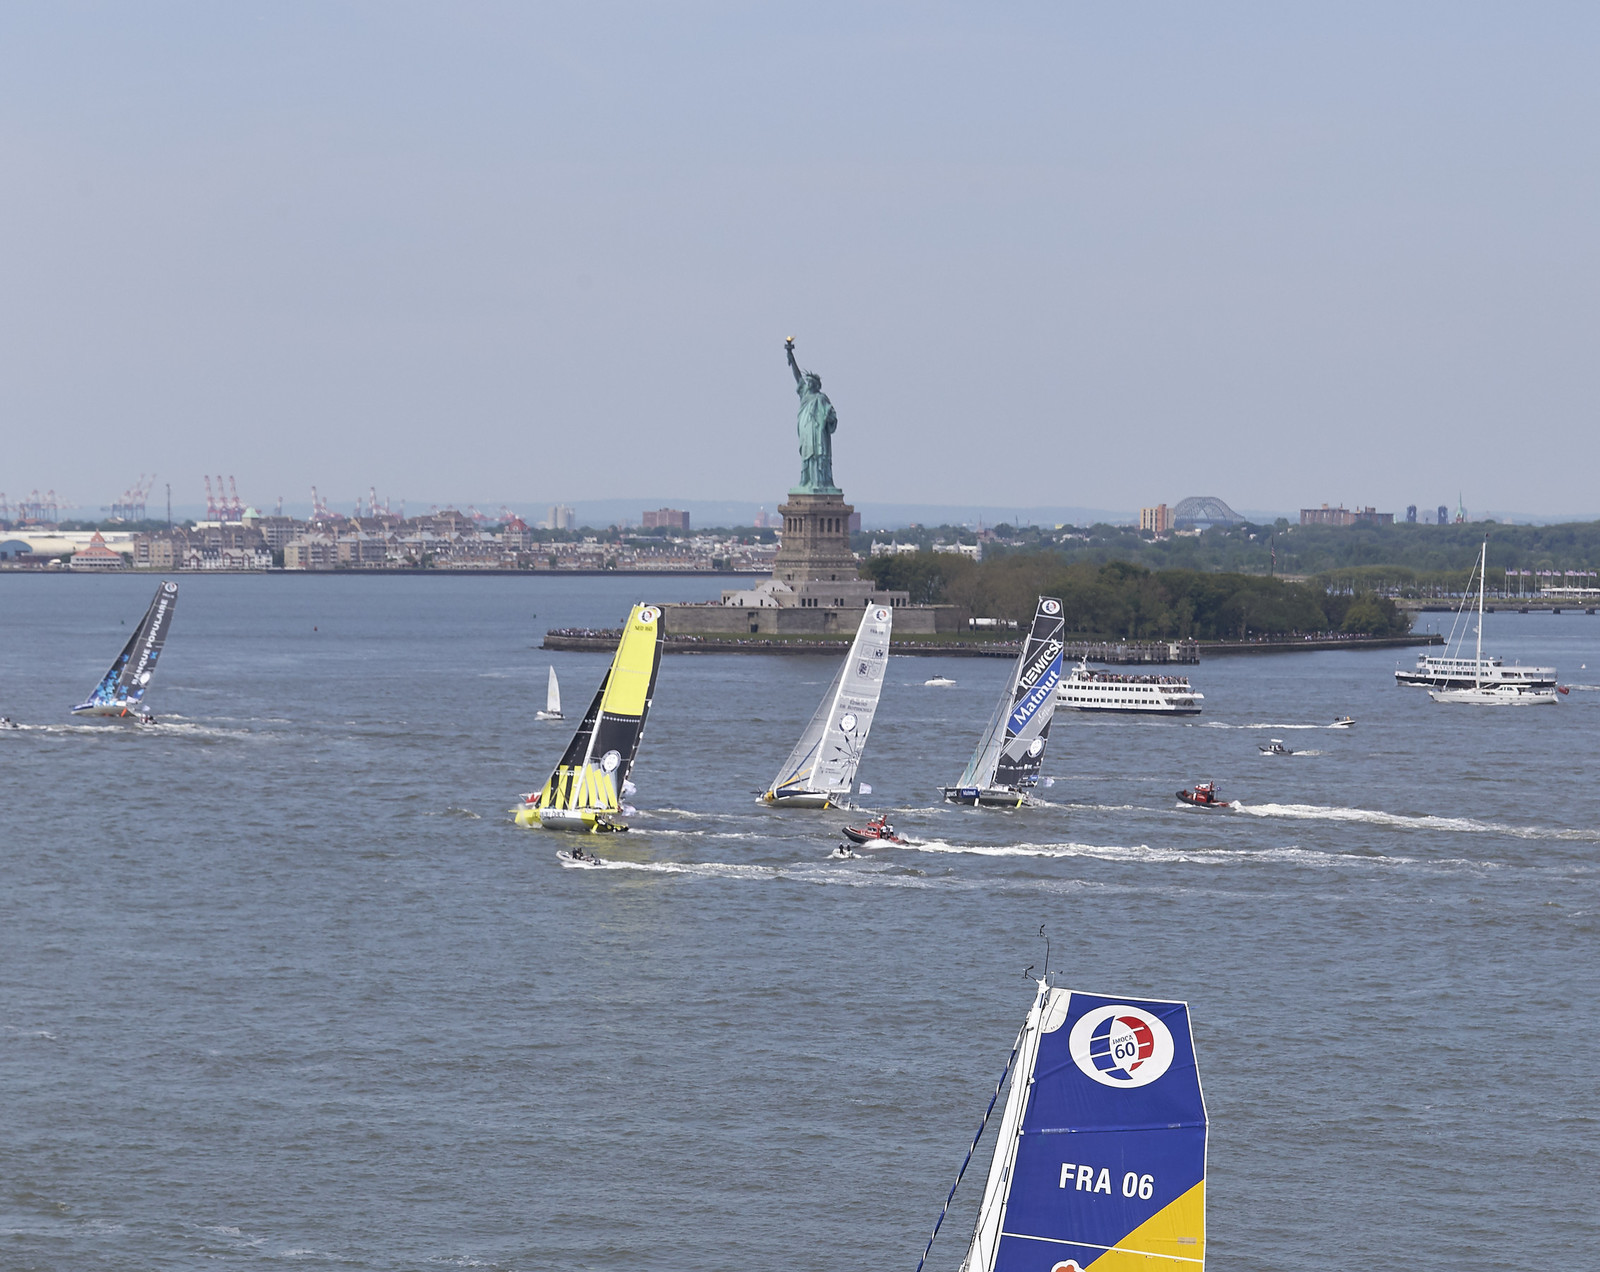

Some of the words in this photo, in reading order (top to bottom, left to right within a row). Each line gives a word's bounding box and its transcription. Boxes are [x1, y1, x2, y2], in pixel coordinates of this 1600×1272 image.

[132, 648, 150, 684] BANQUE
[146, 599, 168, 648] POPULAIRE
[1014, 670, 1060, 725] Matmut
[1112, 1034, 1133, 1045] IMOCA
[1115, 1042, 1136, 1060] 60
[1059, 1162, 1112, 1195] FRA
[1122, 1172, 1154, 1200] 06
